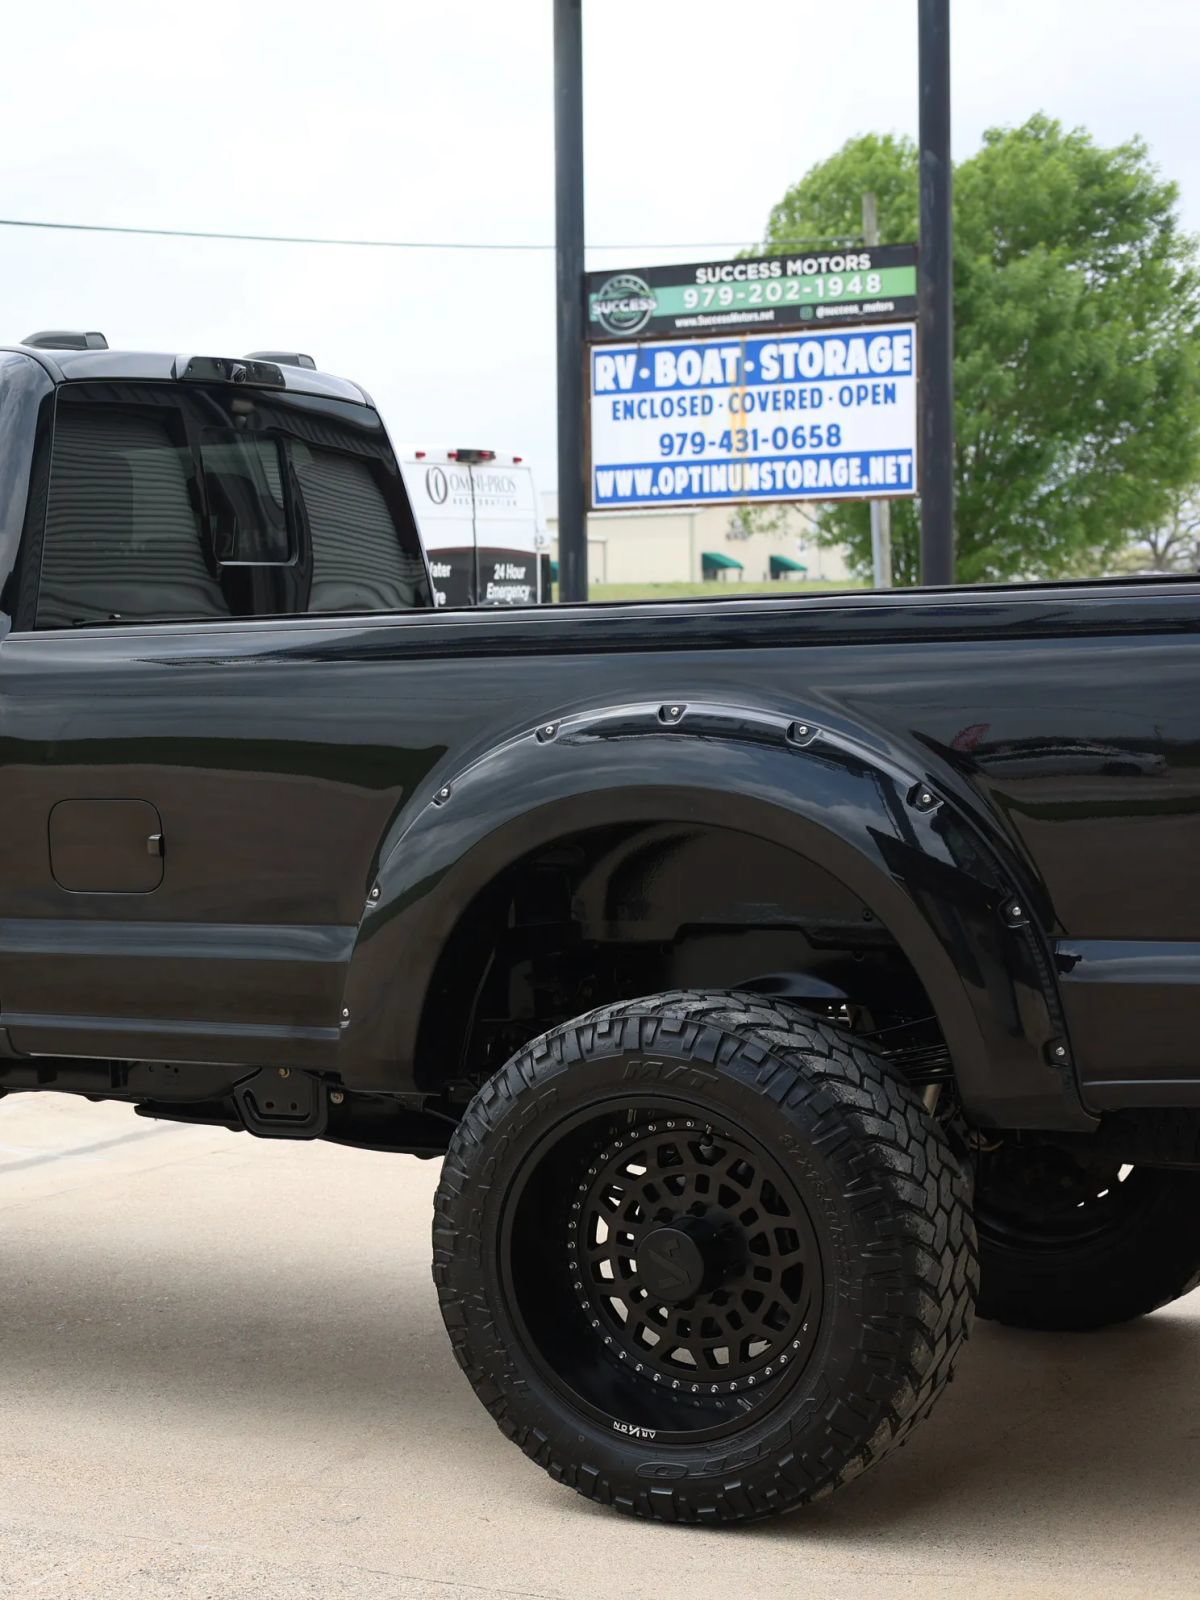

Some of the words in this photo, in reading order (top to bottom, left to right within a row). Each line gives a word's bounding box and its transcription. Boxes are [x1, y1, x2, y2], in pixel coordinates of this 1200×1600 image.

[695, 264, 783, 285] SUCCESS
[786, 253, 872, 277] MOTORS
[591, 298, 657, 315] SUCCESS
[683, 273, 883, 309] 979-202-1948
[595, 353, 638, 391] RV
[654, 347, 742, 388] BOAT
[759, 334, 912, 381] STORAGE
[612, 394, 714, 421] ENCLOSED
[728, 387, 823, 415] COVERED
[839, 383, 897, 408] OPEN
[659, 423, 842, 457] 979-431-0658
[596, 455, 912, 498] WWW.OPTIMUMSTORAGE.NET
[494, 563, 505, 580] 24
[506, 563, 526, 580] Hour
[486, 582, 531, 602] Emergency
[622, 1060, 720, 1089] M/T
